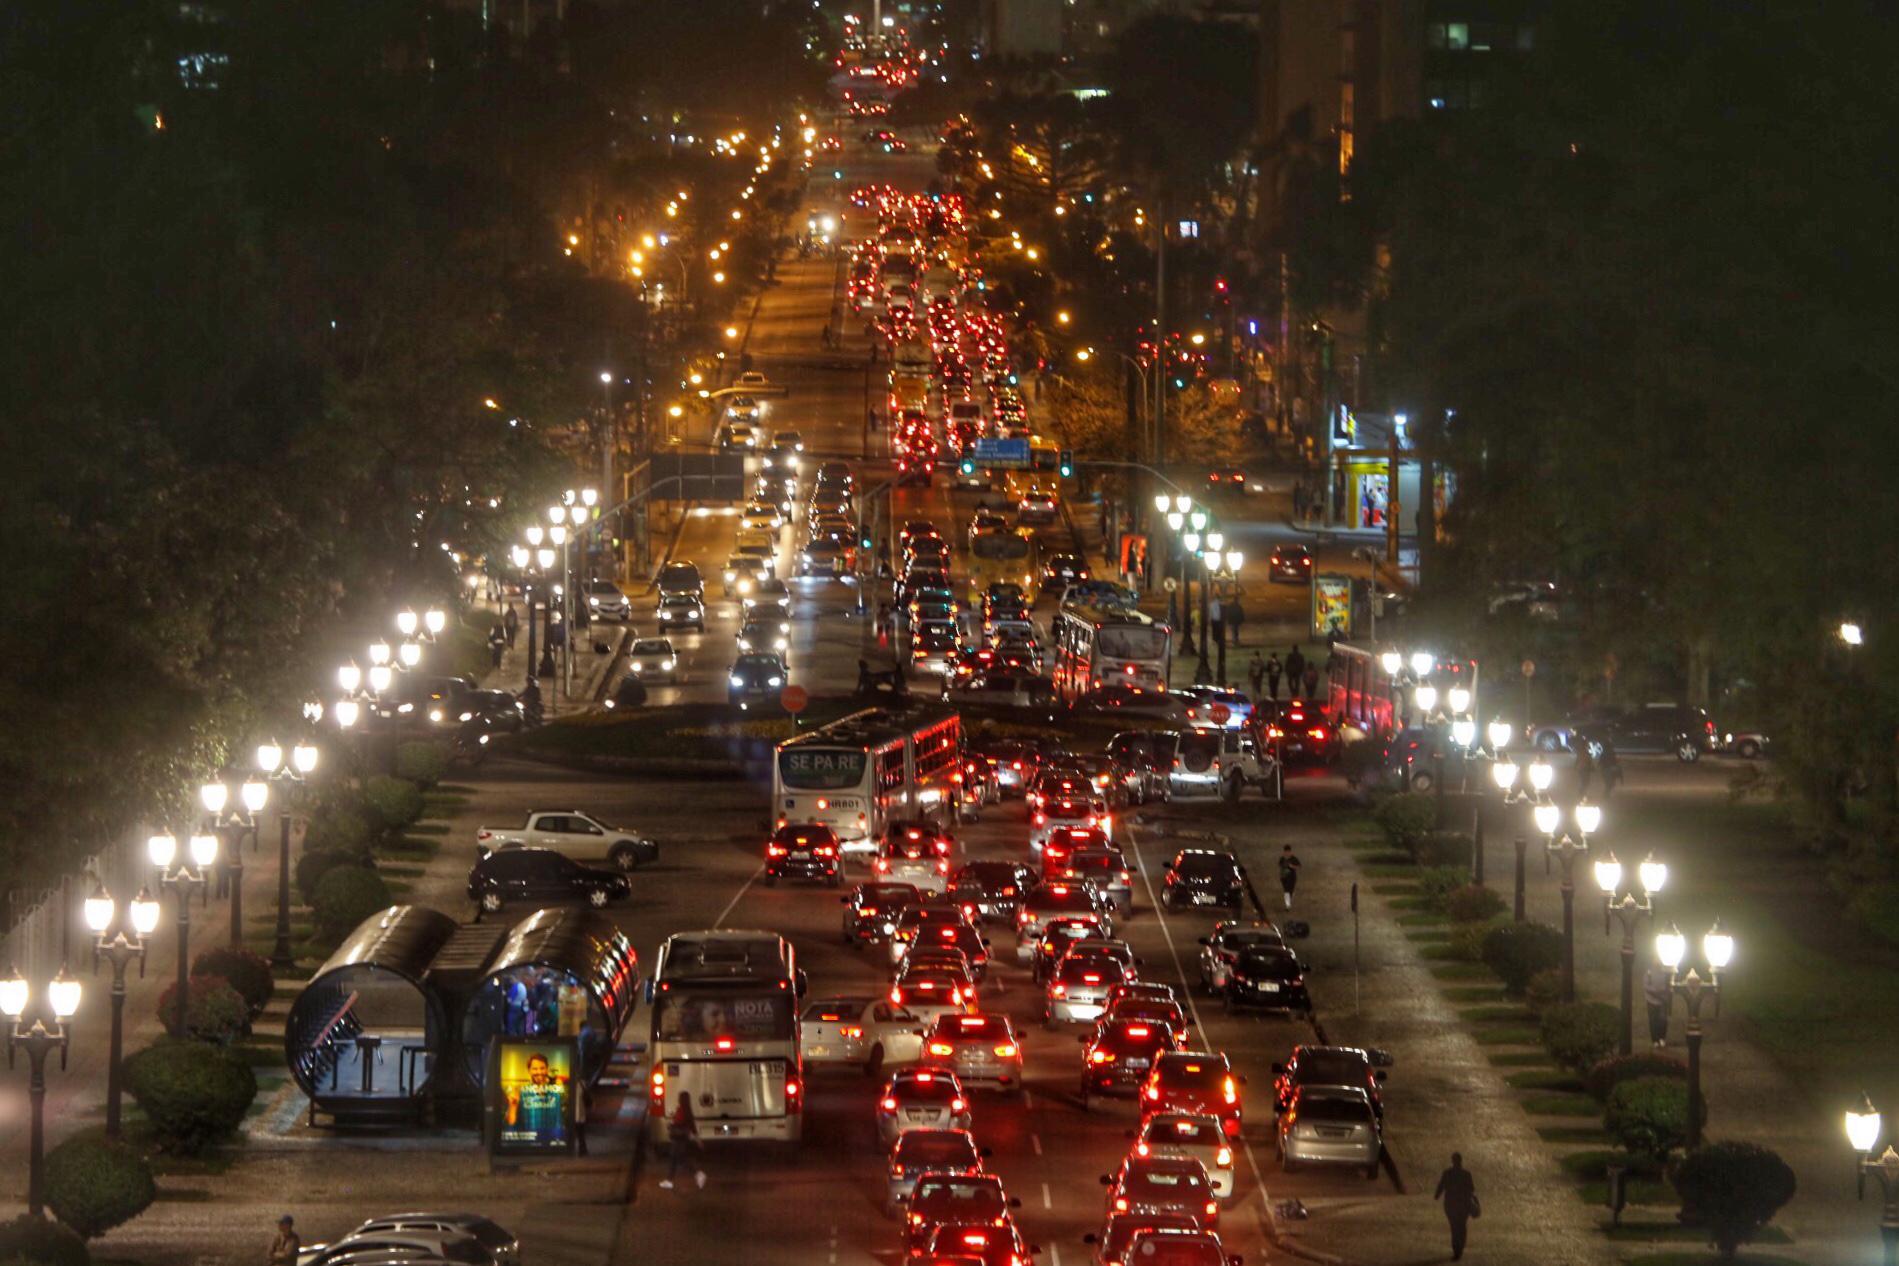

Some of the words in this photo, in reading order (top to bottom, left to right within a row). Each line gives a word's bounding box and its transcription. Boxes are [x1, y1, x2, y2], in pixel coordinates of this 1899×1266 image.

[790, 755, 809, 769] SE
[814, 755, 833, 769] PA
[838, 755, 858, 769] RE
